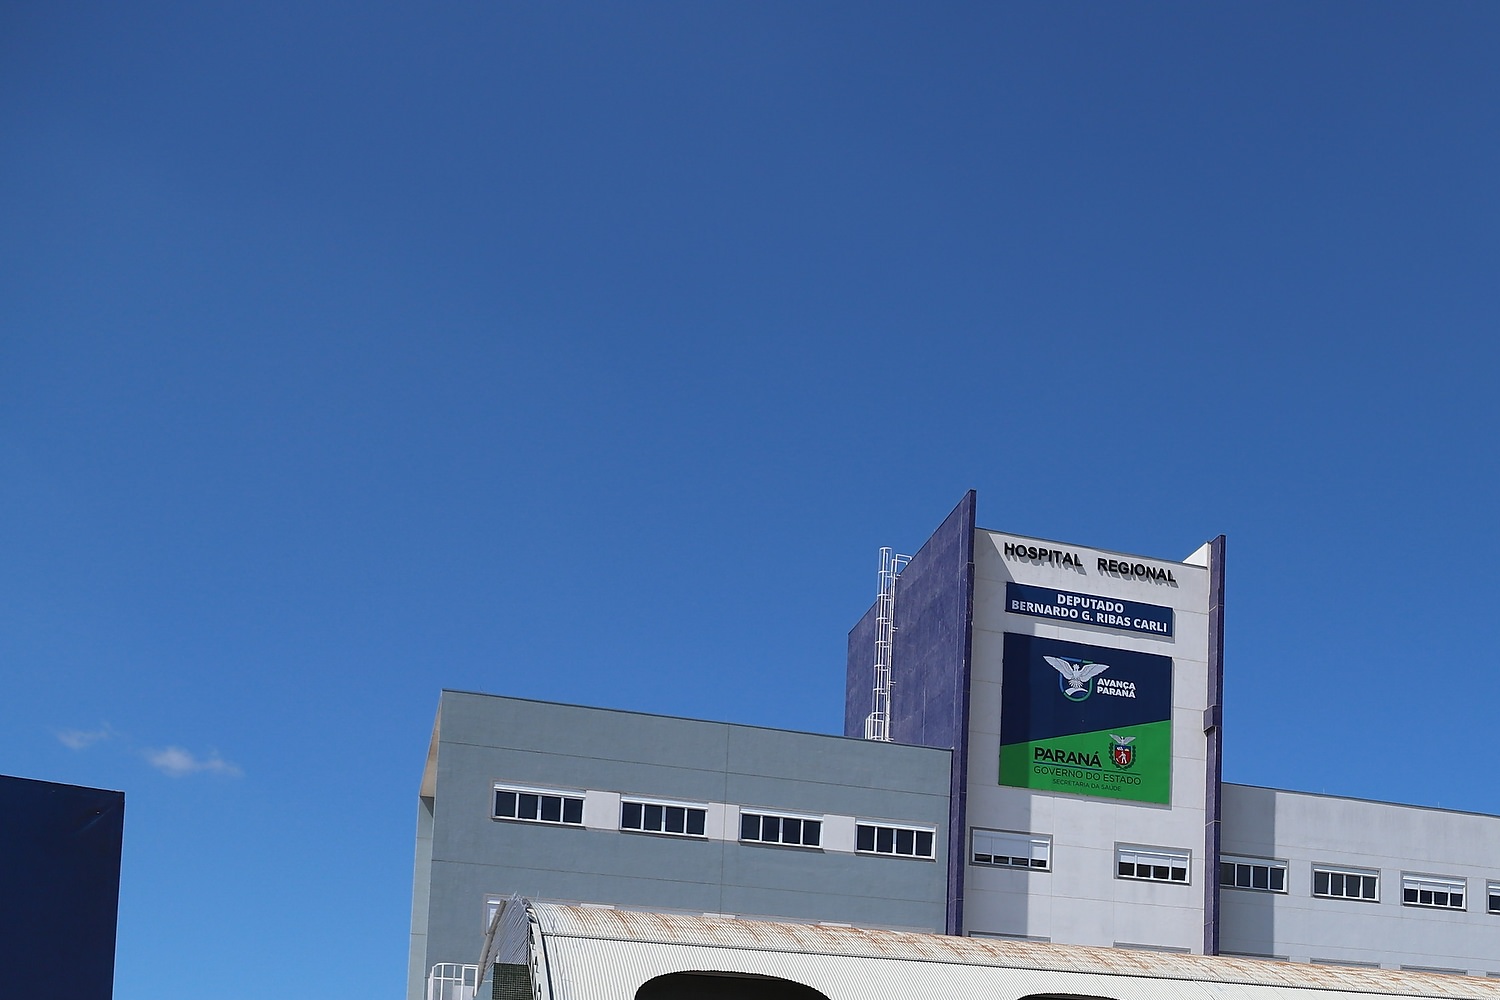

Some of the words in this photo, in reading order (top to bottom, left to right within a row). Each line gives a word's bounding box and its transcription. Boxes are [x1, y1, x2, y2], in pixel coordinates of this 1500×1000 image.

[1003, 542, 1083, 567] HOSPITAL
[1097, 557, 1176, 583] REGIONAL
[1057, 593, 1124, 614] DEPUTADO
[1011, 600, 1079, 619] BERNARDO
[1081, 612, 1094, 622] G.
[1096, 613, 1131, 627] RIBAS
[1133, 618, 1167, 633] CARLI
[1097, 678, 1136, 690] AVANÇA
[1097, 686, 1136, 698] PARANÁ
[1034, 747, 1102, 768] PARANÁ
[1033, 765, 1083, 779] GOVERNO
[1085, 772, 1101, 781] DO
[1103, 775, 1142, 786] ESTADO
[1053, 779, 1090, 788] SECRETARIA
